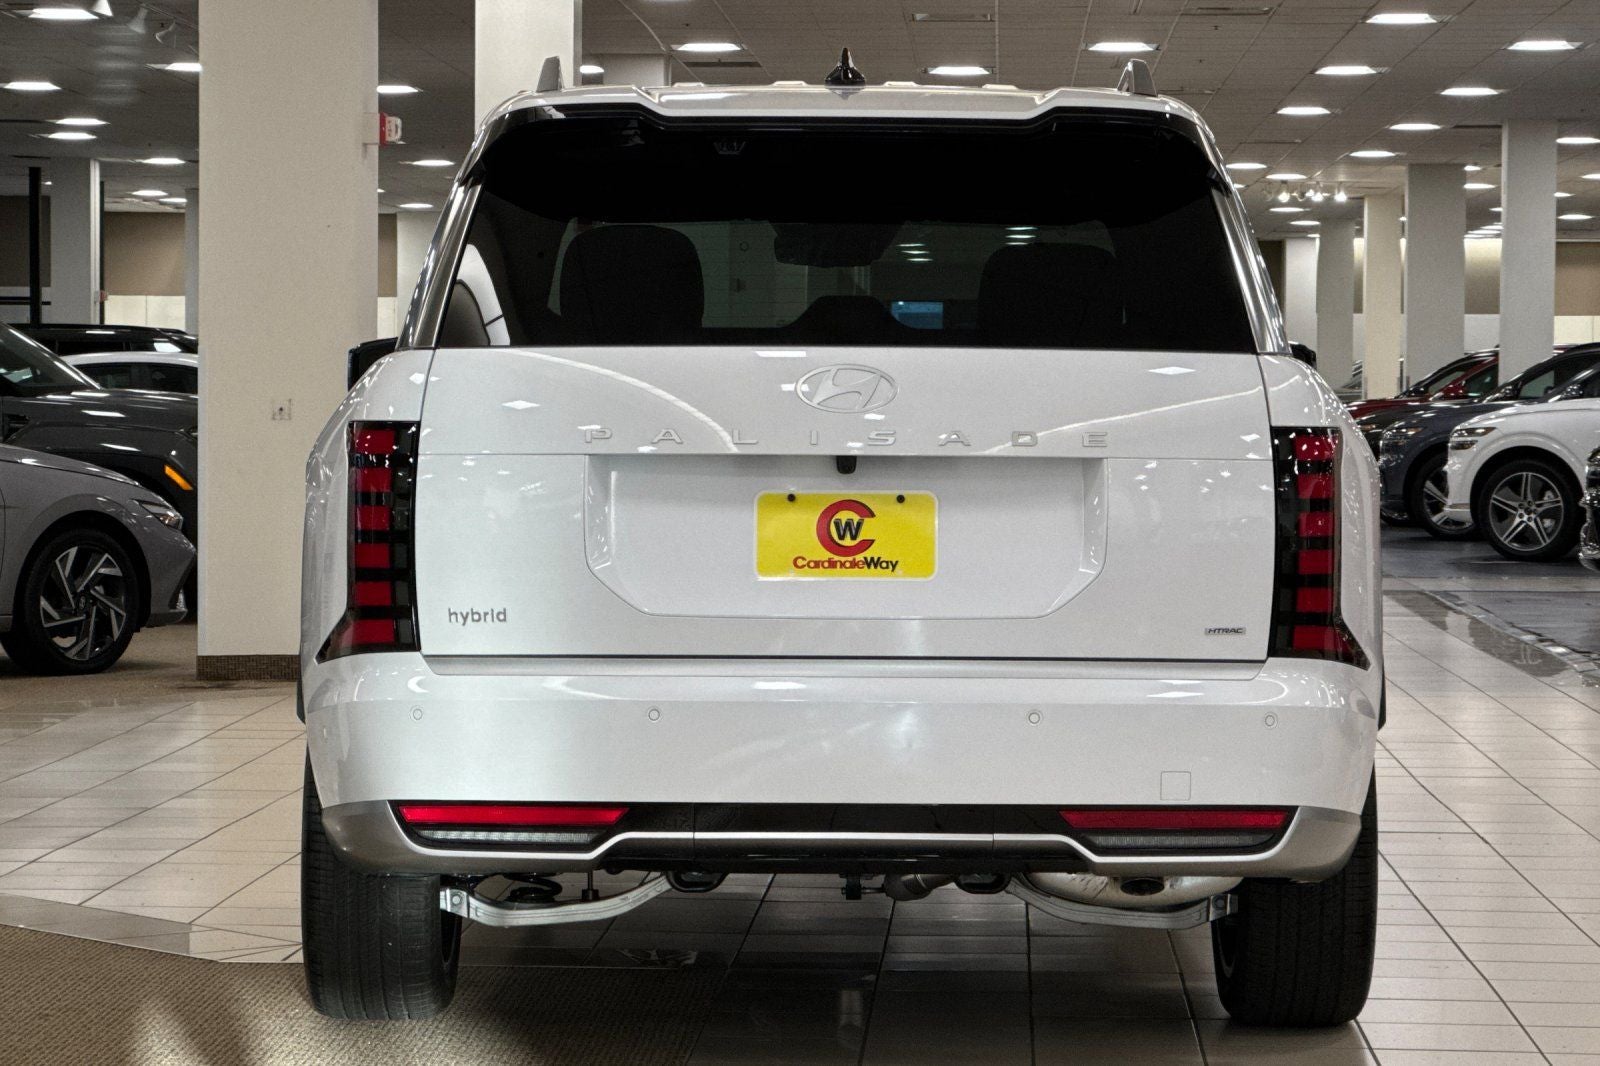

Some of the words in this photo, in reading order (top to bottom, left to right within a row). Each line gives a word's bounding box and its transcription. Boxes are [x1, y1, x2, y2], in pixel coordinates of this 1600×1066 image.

[583, 428, 1108, 448] PALISADE
[792, 556, 899, 572] CardinaleWay
[448, 607, 507, 626] hybrid
[1207, 627, 1244, 635] HTRAC
